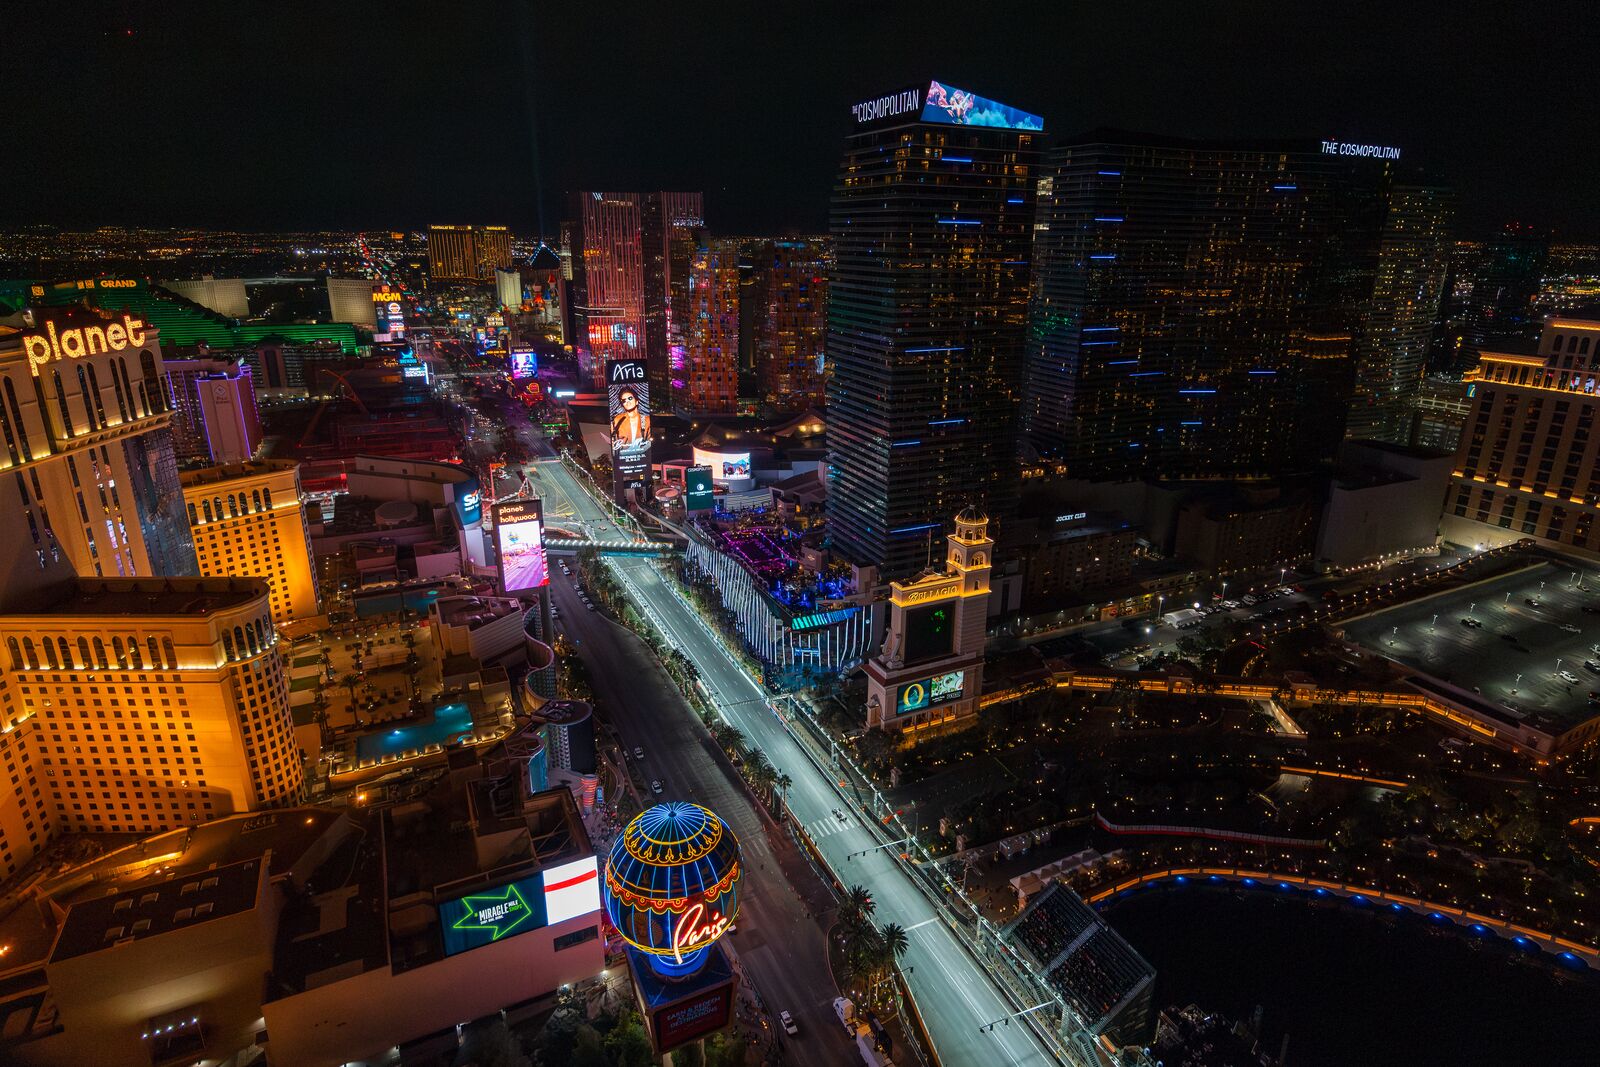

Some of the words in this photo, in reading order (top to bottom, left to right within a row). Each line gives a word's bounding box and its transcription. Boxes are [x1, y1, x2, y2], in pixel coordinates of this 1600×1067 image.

[858, 88, 919, 123] COSMOPOLITAN
[1321, 141, 1339, 155] THE
[1339, 143, 1401, 160] COSMOPOLITAN
[100, 280, 136, 288] GRAND
[373, 293, 402, 301] MGM
[23, 315, 145, 377] planet
[613, 363, 644, 381] Aria
[499, 506, 525, 516] planet
[499, 513, 538, 524] hollywood
[908, 585, 959, 602] BELLAGIO
[903, 683, 925, 707] O
[479, 903, 509, 922] MIRACLE
[673, 903, 728, 965] Paris
